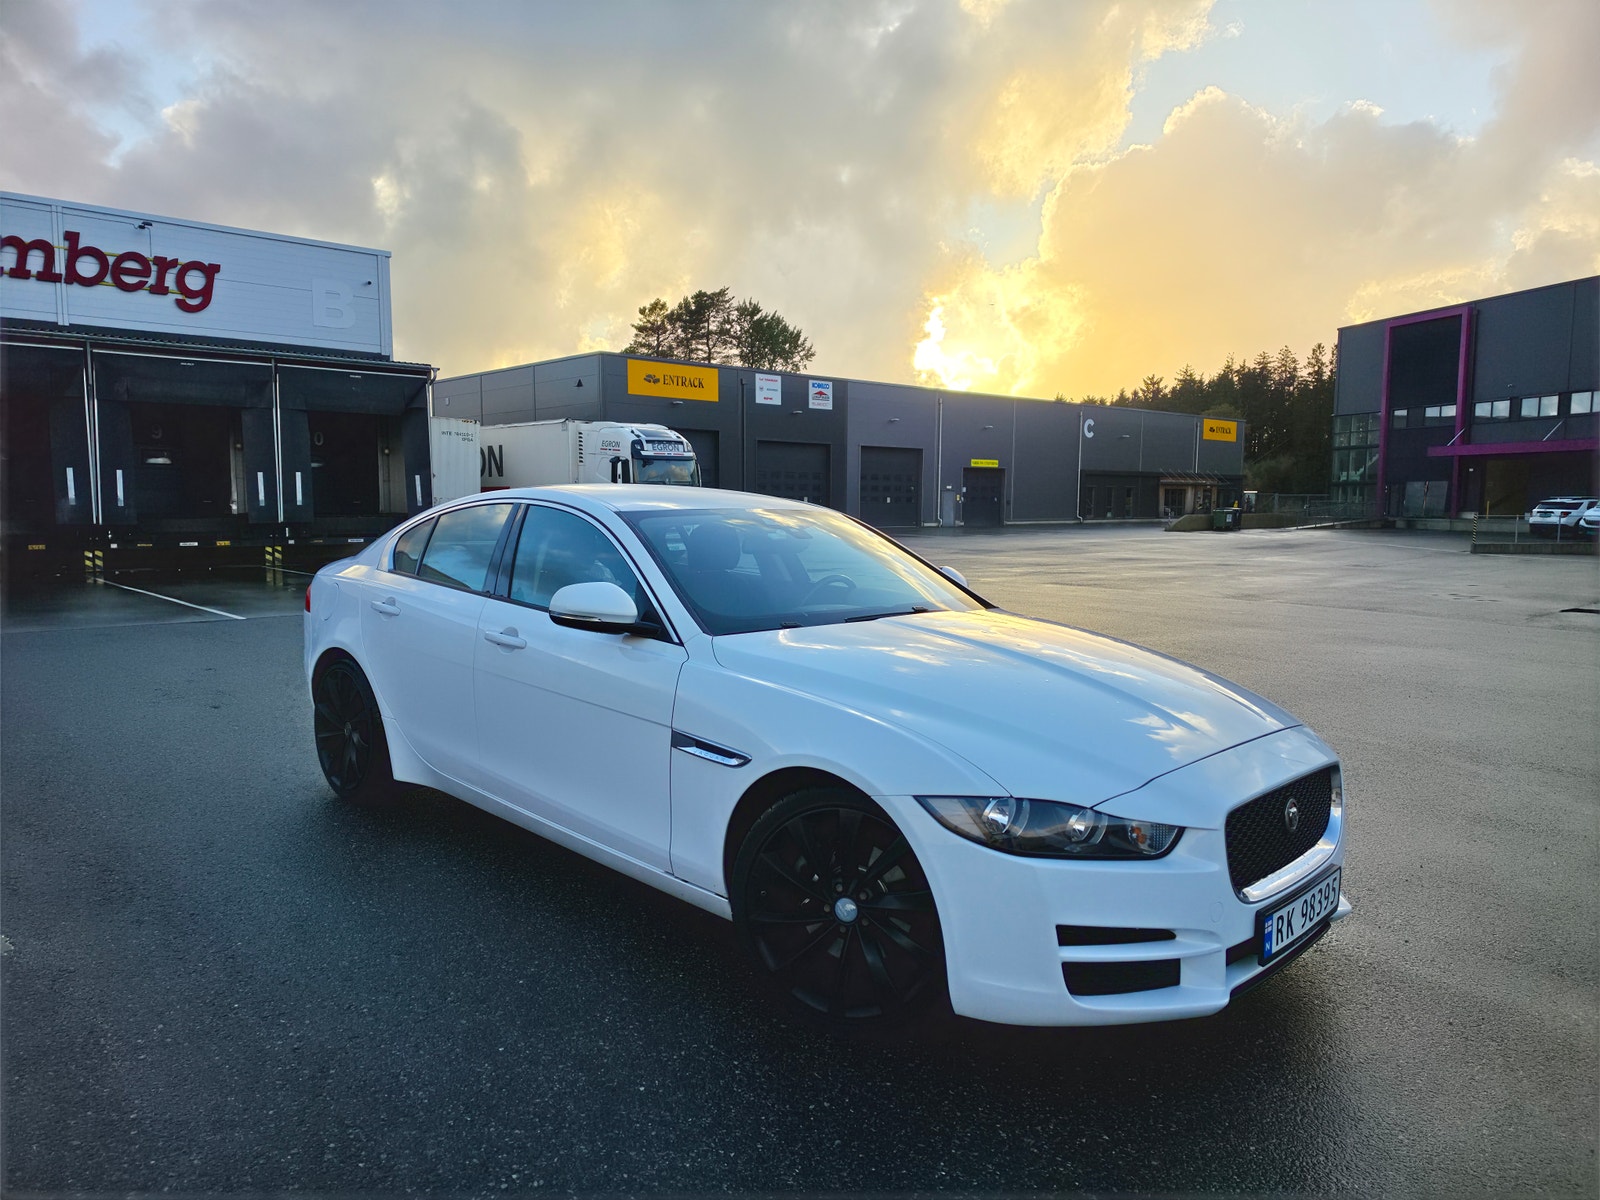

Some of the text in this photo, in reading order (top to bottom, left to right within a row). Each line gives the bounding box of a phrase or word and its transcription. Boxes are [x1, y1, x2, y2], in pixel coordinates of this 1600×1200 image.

[0, 231, 221, 313] mberg
[312, 279, 355, 329] B
[663, 374, 704, 389] ENTRACK
[1084, 418, 1095, 438] C
[601, 440, 621, 448] EGRON
[652, 443, 680, 452] EGRON
[1276, 877, 1337, 946] RK 98395
[1265, 941, 1271, 951] N
